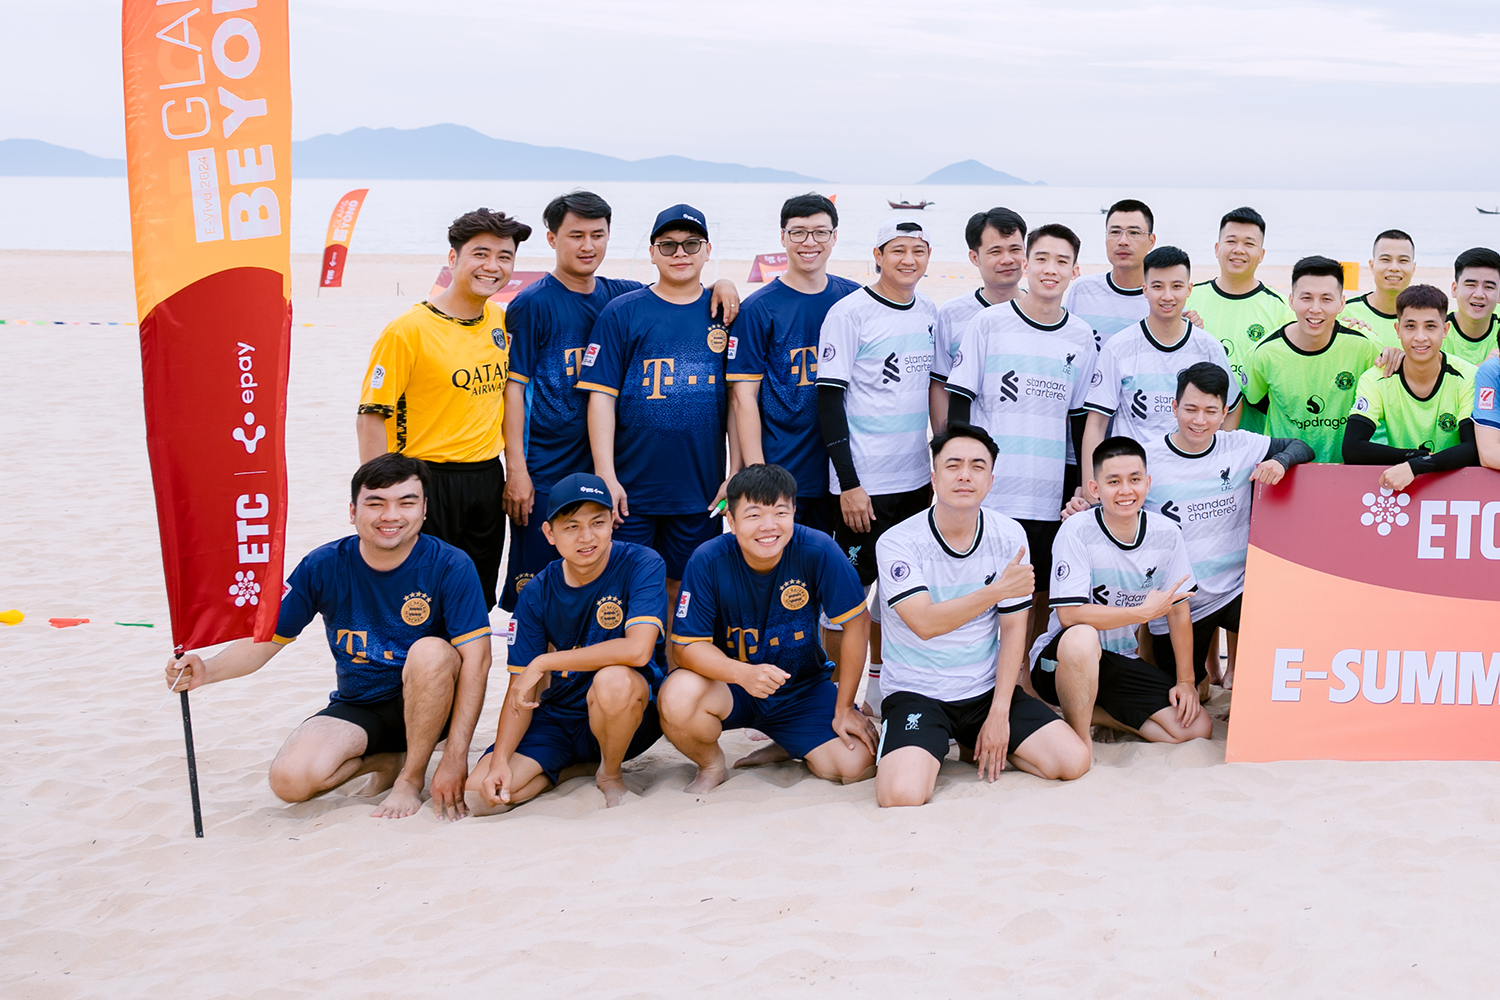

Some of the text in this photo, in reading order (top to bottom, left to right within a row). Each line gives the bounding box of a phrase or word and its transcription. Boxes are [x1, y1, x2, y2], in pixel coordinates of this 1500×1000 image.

[197, 156, 216, 235] E-Vivu 2024
[237, 341, 258, 404] epay
[1154, 394, 1175, 404] stan
[1187, 494, 1235, 513] standard
[1188, 502, 1237, 522] chartered
[236, 493, 270, 564] ETC
